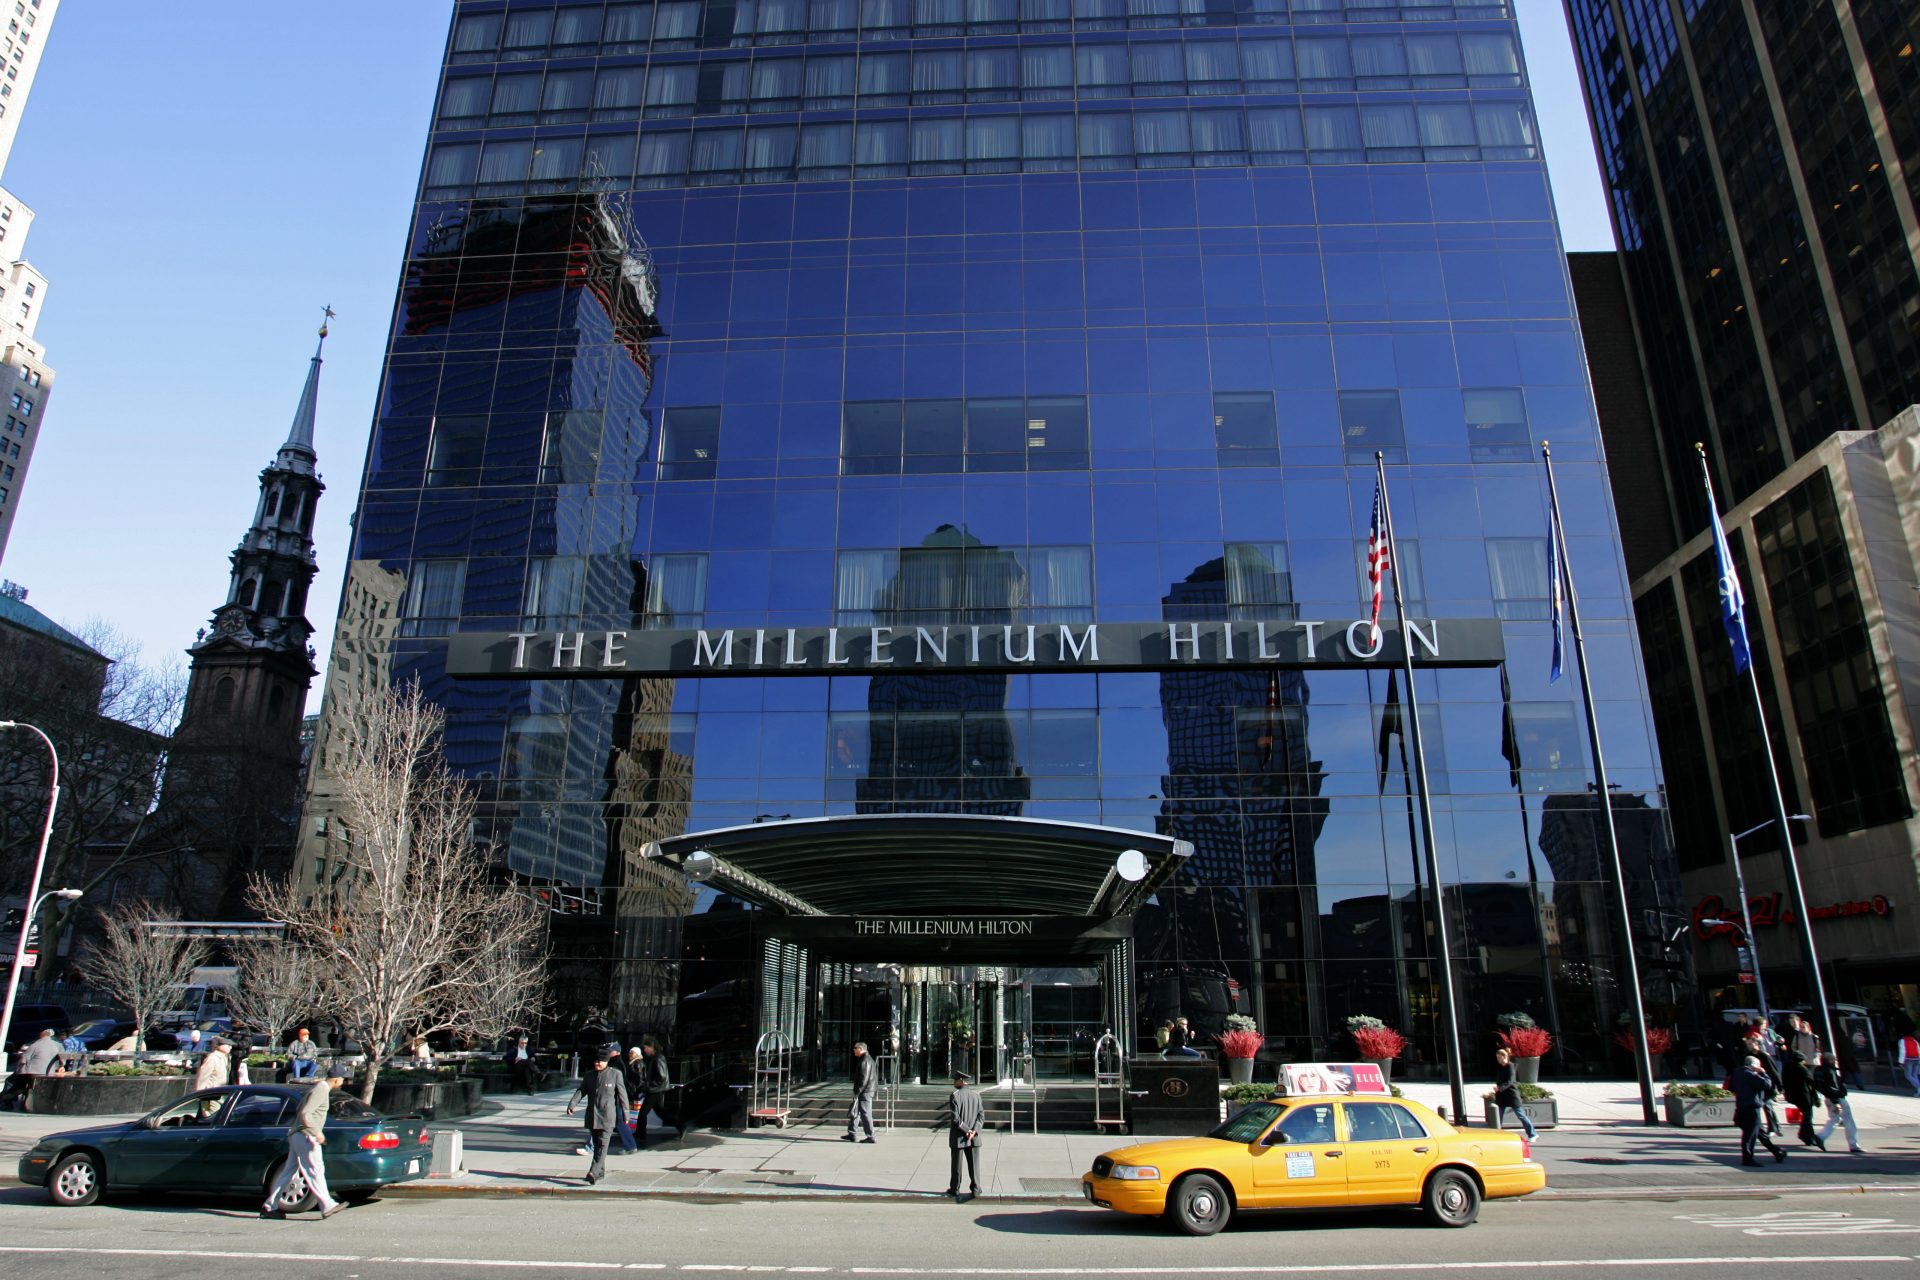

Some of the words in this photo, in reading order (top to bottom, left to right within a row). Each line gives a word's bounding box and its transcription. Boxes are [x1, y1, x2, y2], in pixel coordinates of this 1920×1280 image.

[508, 631, 627, 669] THE
[692, 624, 1099, 666] MILLENIUM
[1168, 618, 1441, 660] HILTON
[855, 920, 885, 934] THE
[889, 920, 974, 935] MILLENIUM
[978, 920, 1032, 935] HILTON
[1356, 1073, 1381, 1083] ELLE
[1374, 1160, 1391, 1169] 3Y75
